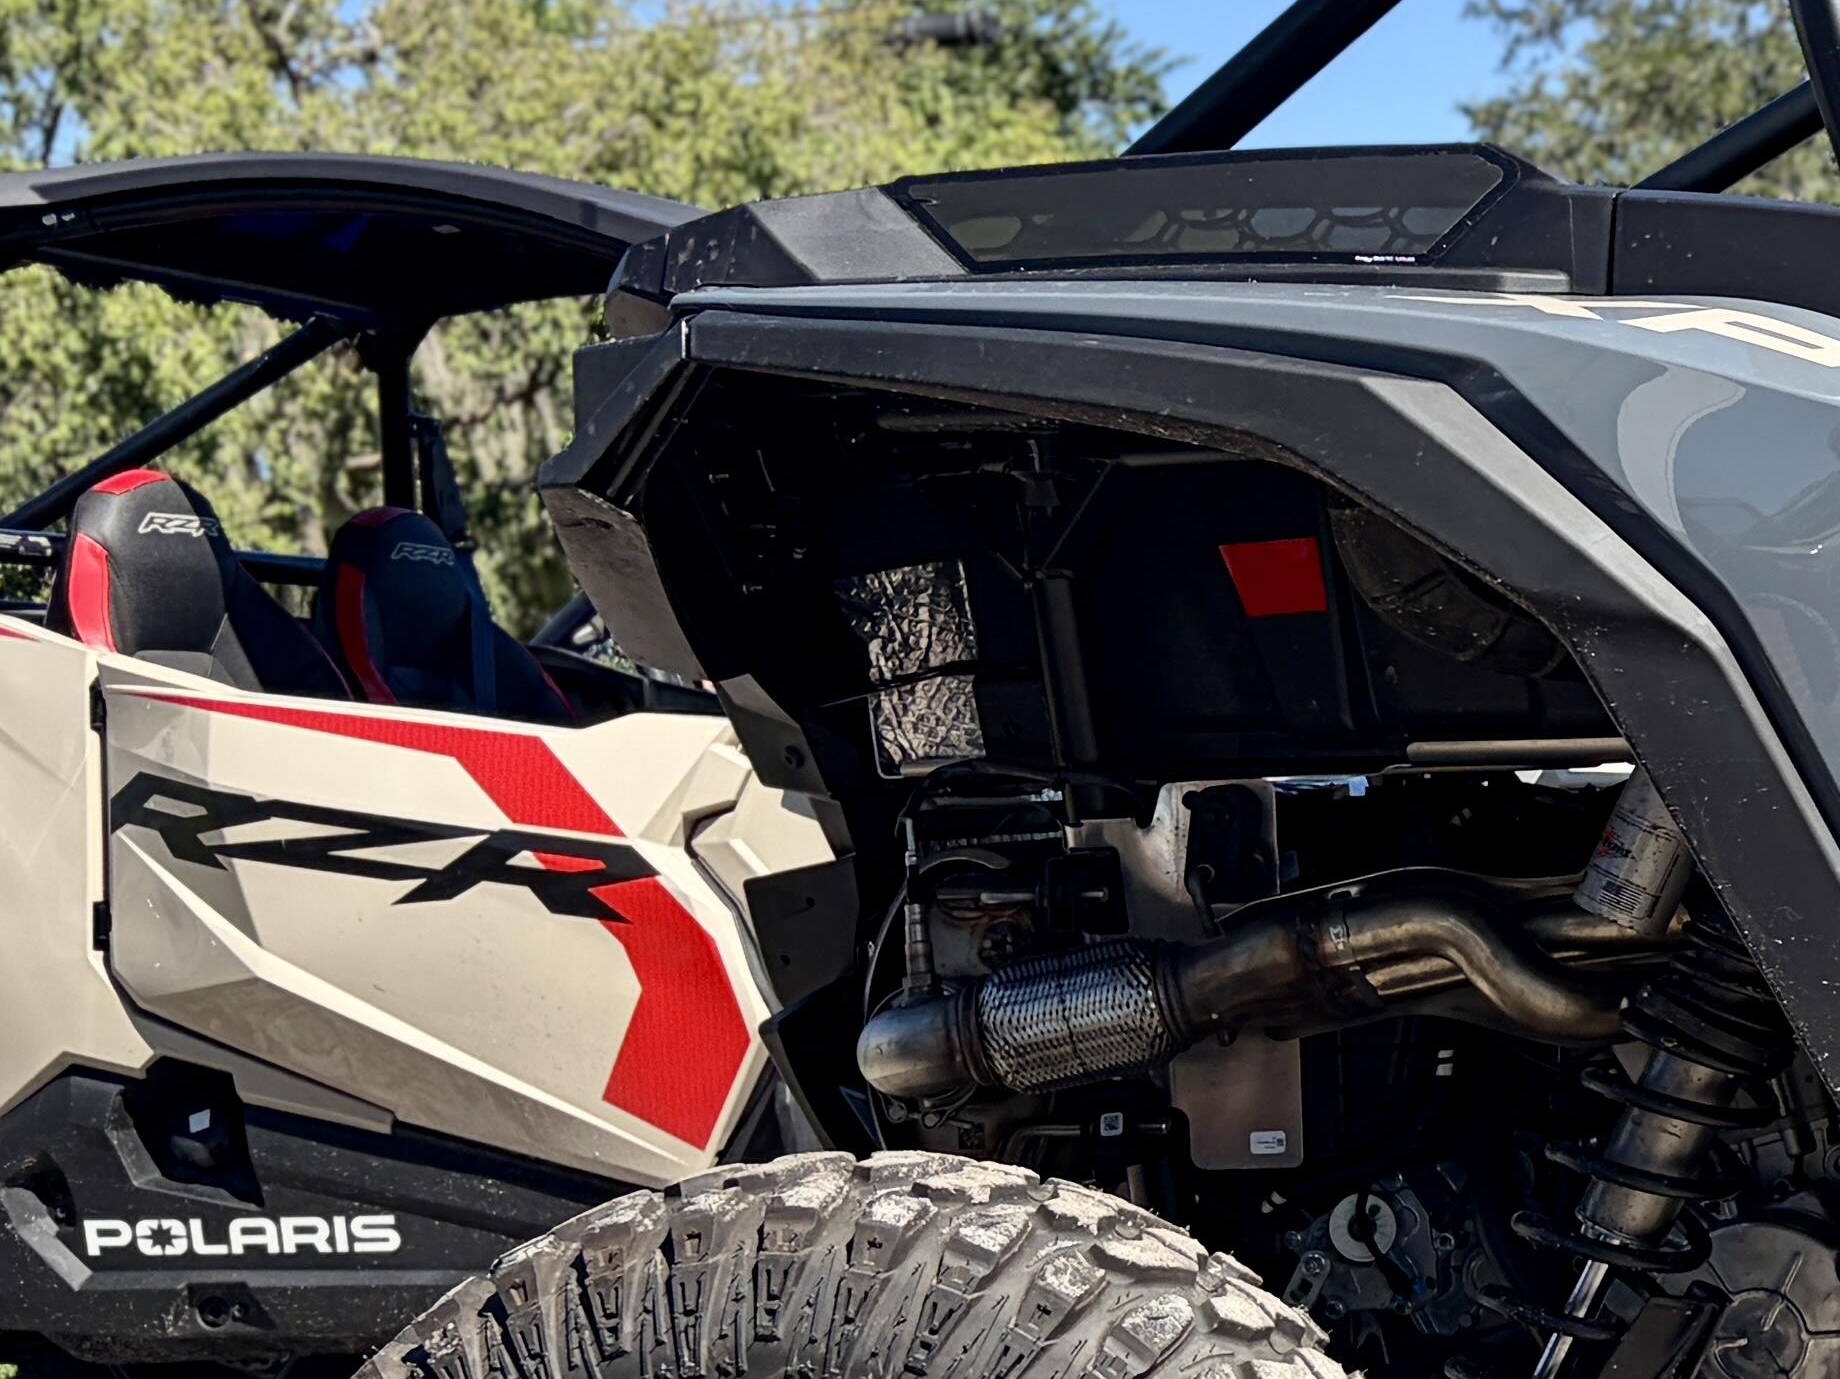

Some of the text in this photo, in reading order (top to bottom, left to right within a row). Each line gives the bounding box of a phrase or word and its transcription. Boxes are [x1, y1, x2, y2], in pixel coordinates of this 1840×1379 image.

[138, 511, 219, 537] RZR
[391, 542, 456, 565] RZR
[111, 771, 662, 925] RZR
[83, 1214, 402, 1257] POLARIS
